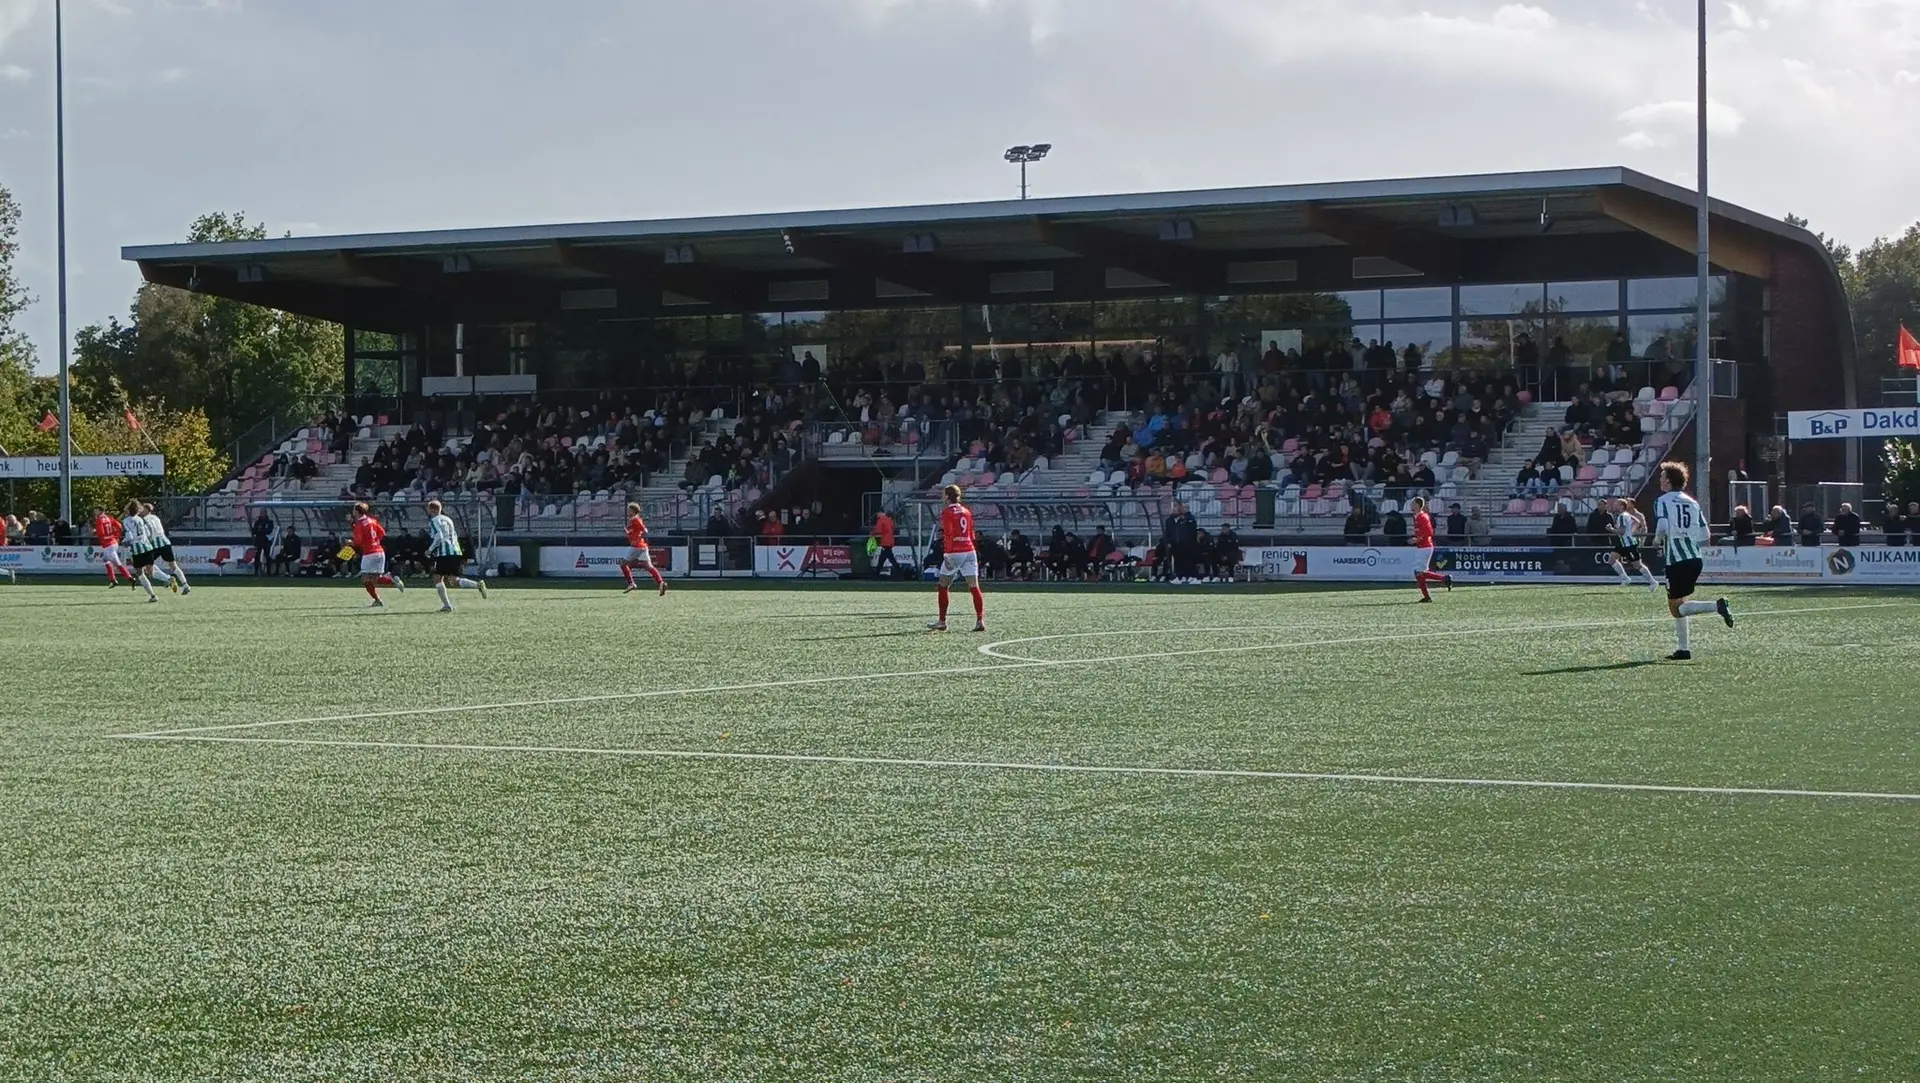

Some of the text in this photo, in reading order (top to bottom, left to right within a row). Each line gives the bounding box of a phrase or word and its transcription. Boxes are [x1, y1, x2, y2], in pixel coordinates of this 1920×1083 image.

[1811, 410, 1918, 435] B&P Dakd
[106, 458, 153, 470] heutink.
[1676, 504, 1691, 529] 15
[960, 517, 968, 534] 9
[1455, 561, 1542, 570] BOUWCENTER
